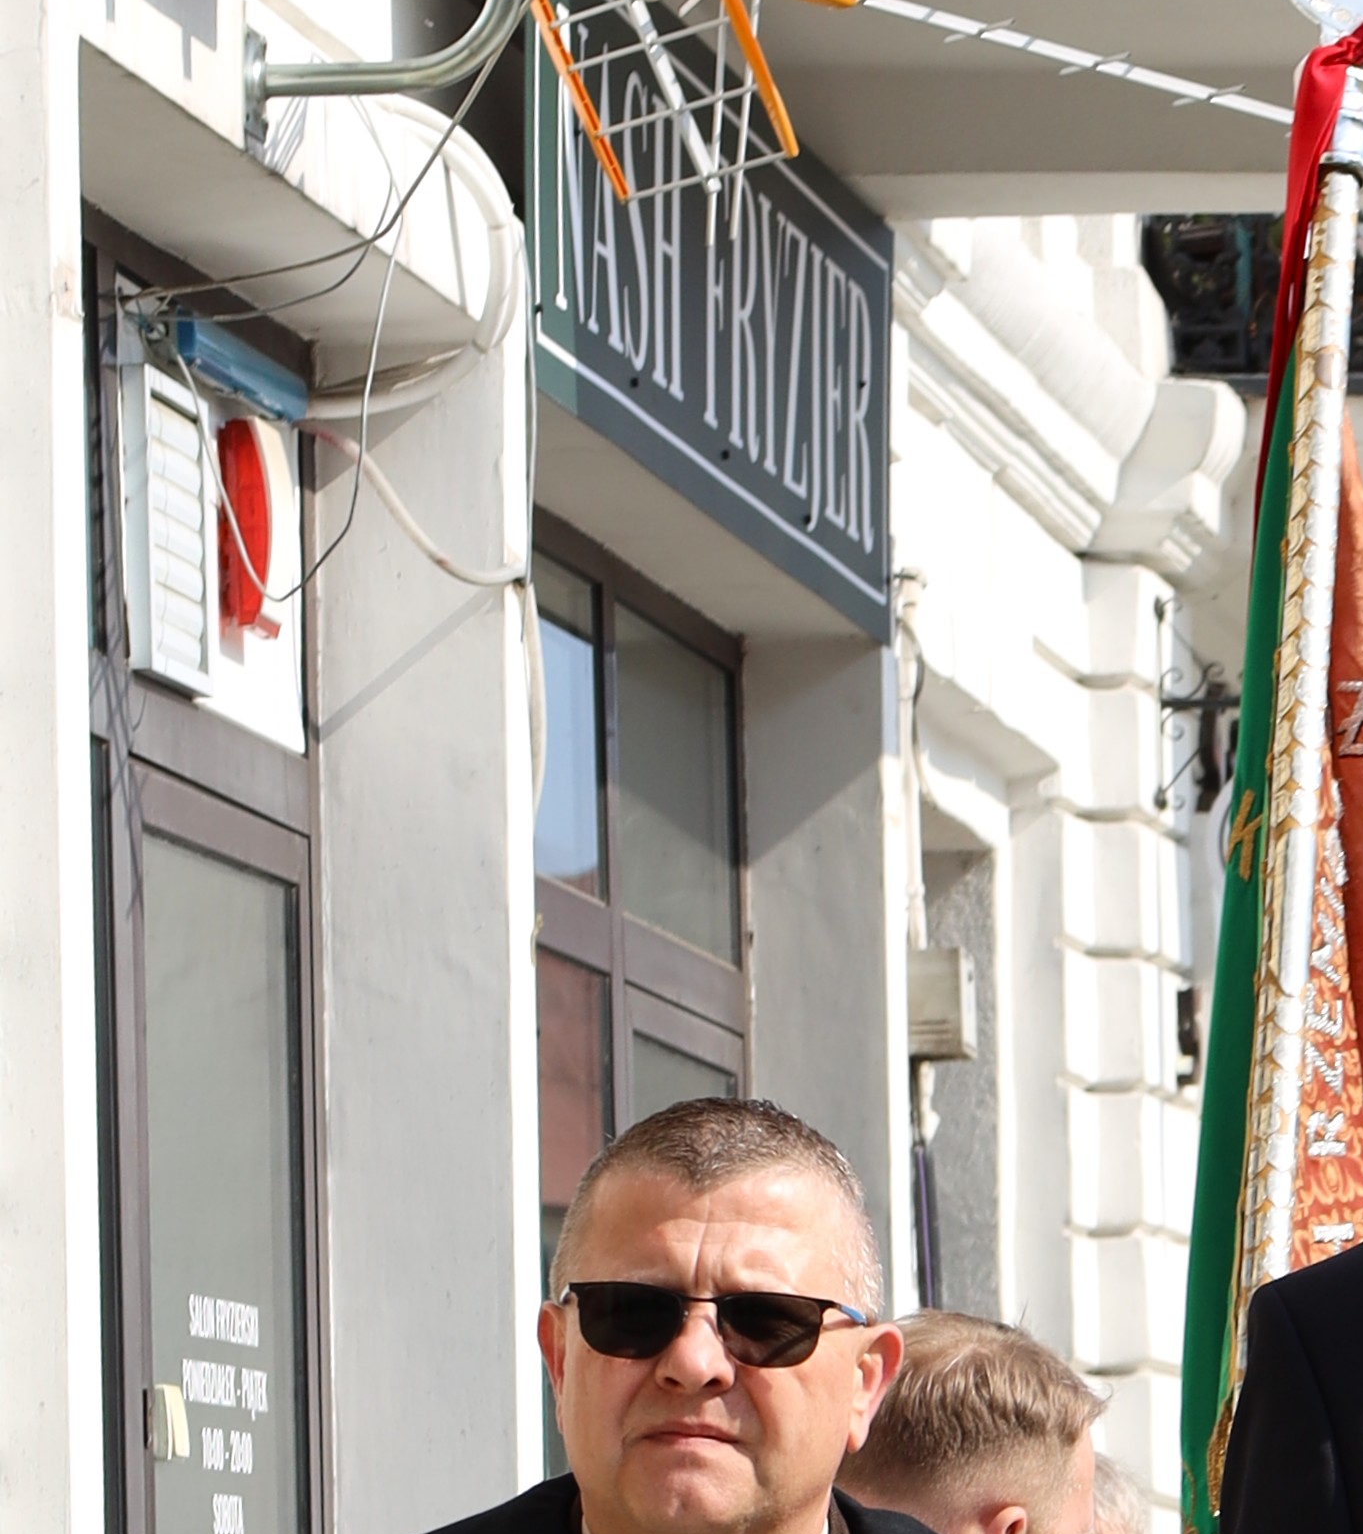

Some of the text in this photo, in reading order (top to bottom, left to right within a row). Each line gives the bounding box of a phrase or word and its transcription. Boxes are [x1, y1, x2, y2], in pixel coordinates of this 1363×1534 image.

[554, 1, 875, 556] NASH FRYZJER
[189, 1293, 215, 1339] SALON
[182, 1358, 237, 1408] PONIEDZIAŁEK
[241, 1368, 269, 1422] PIĄTEK
